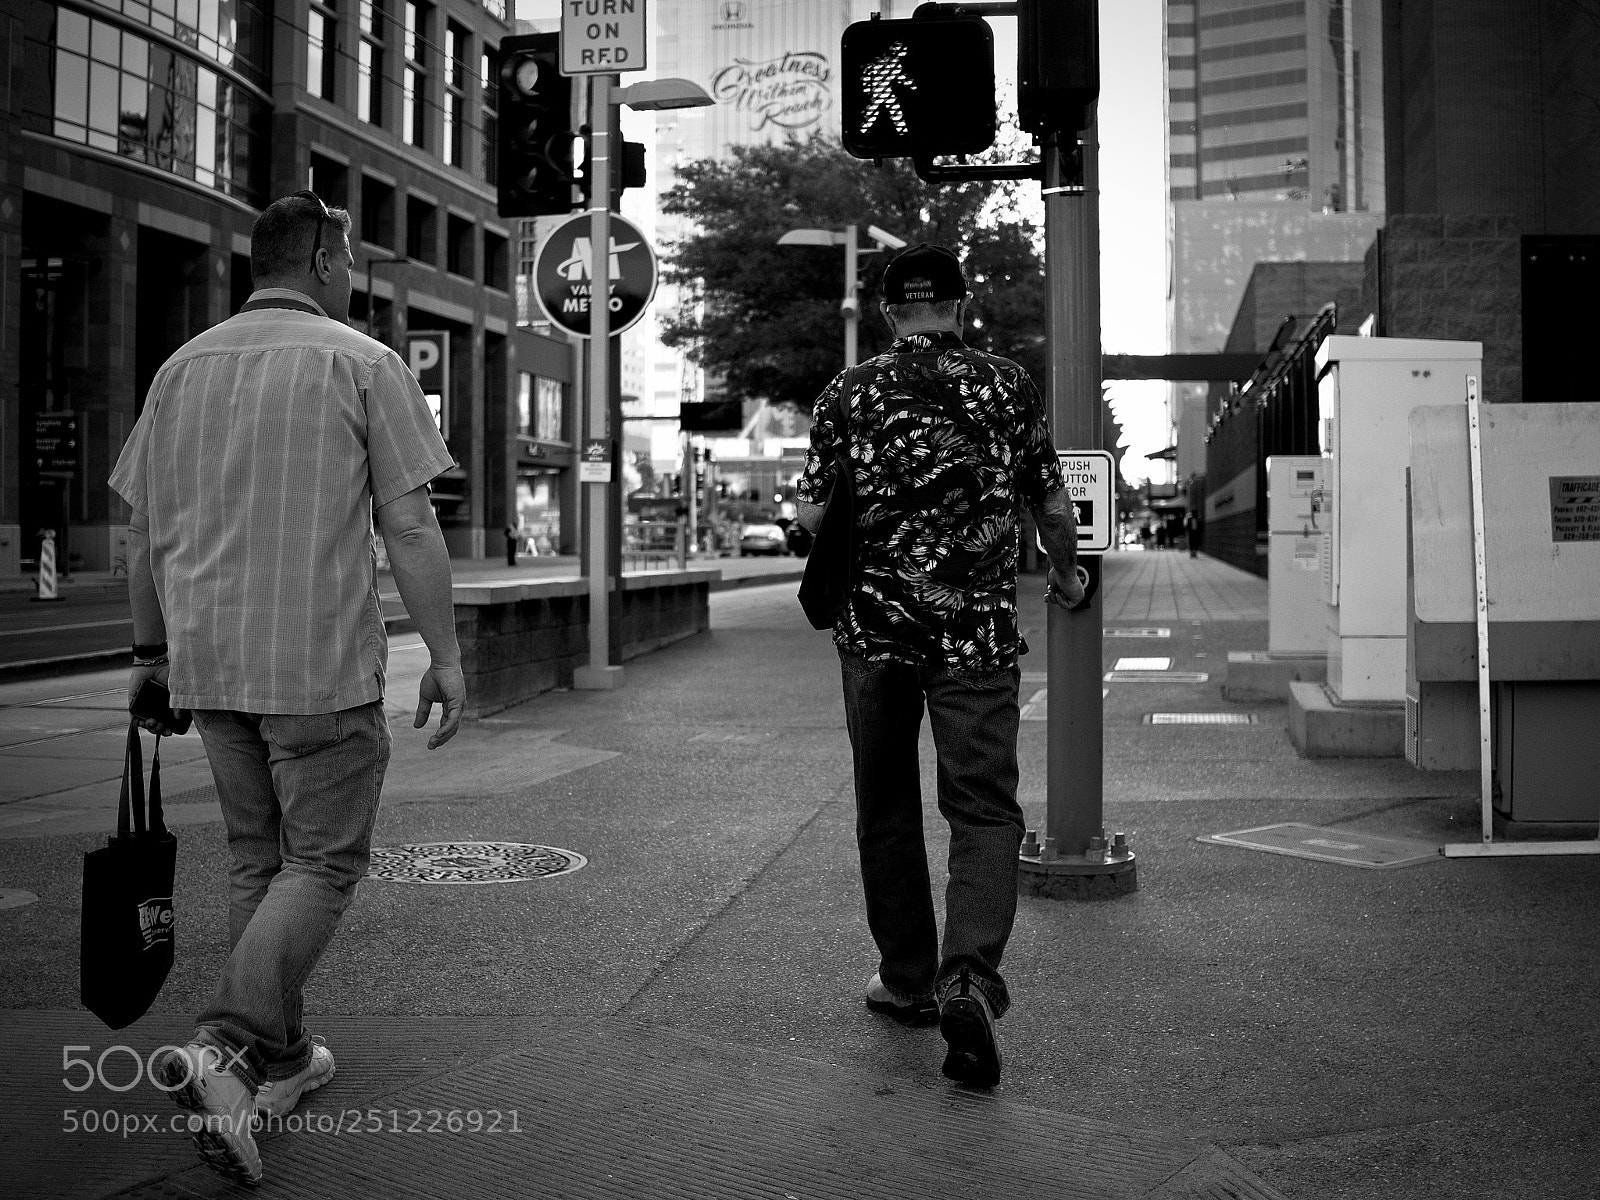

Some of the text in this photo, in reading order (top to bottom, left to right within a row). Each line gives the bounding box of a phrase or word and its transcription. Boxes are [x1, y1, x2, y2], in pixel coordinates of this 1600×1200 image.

[570, 0, 635, 17] TURN
[586, 22, 619, 39] ON
[581, 47, 628, 65] RED
[711, 51, 831, 104] Greatness
[570, 284, 616, 296] VAY
[905, 291, 934, 300] VETERAN
[563, 298, 623, 313] MEO
[409, 339, 440, 380] P
[1061, 461, 1091, 471] PUSH
[1063, 474, 1098, 484] UTTON
